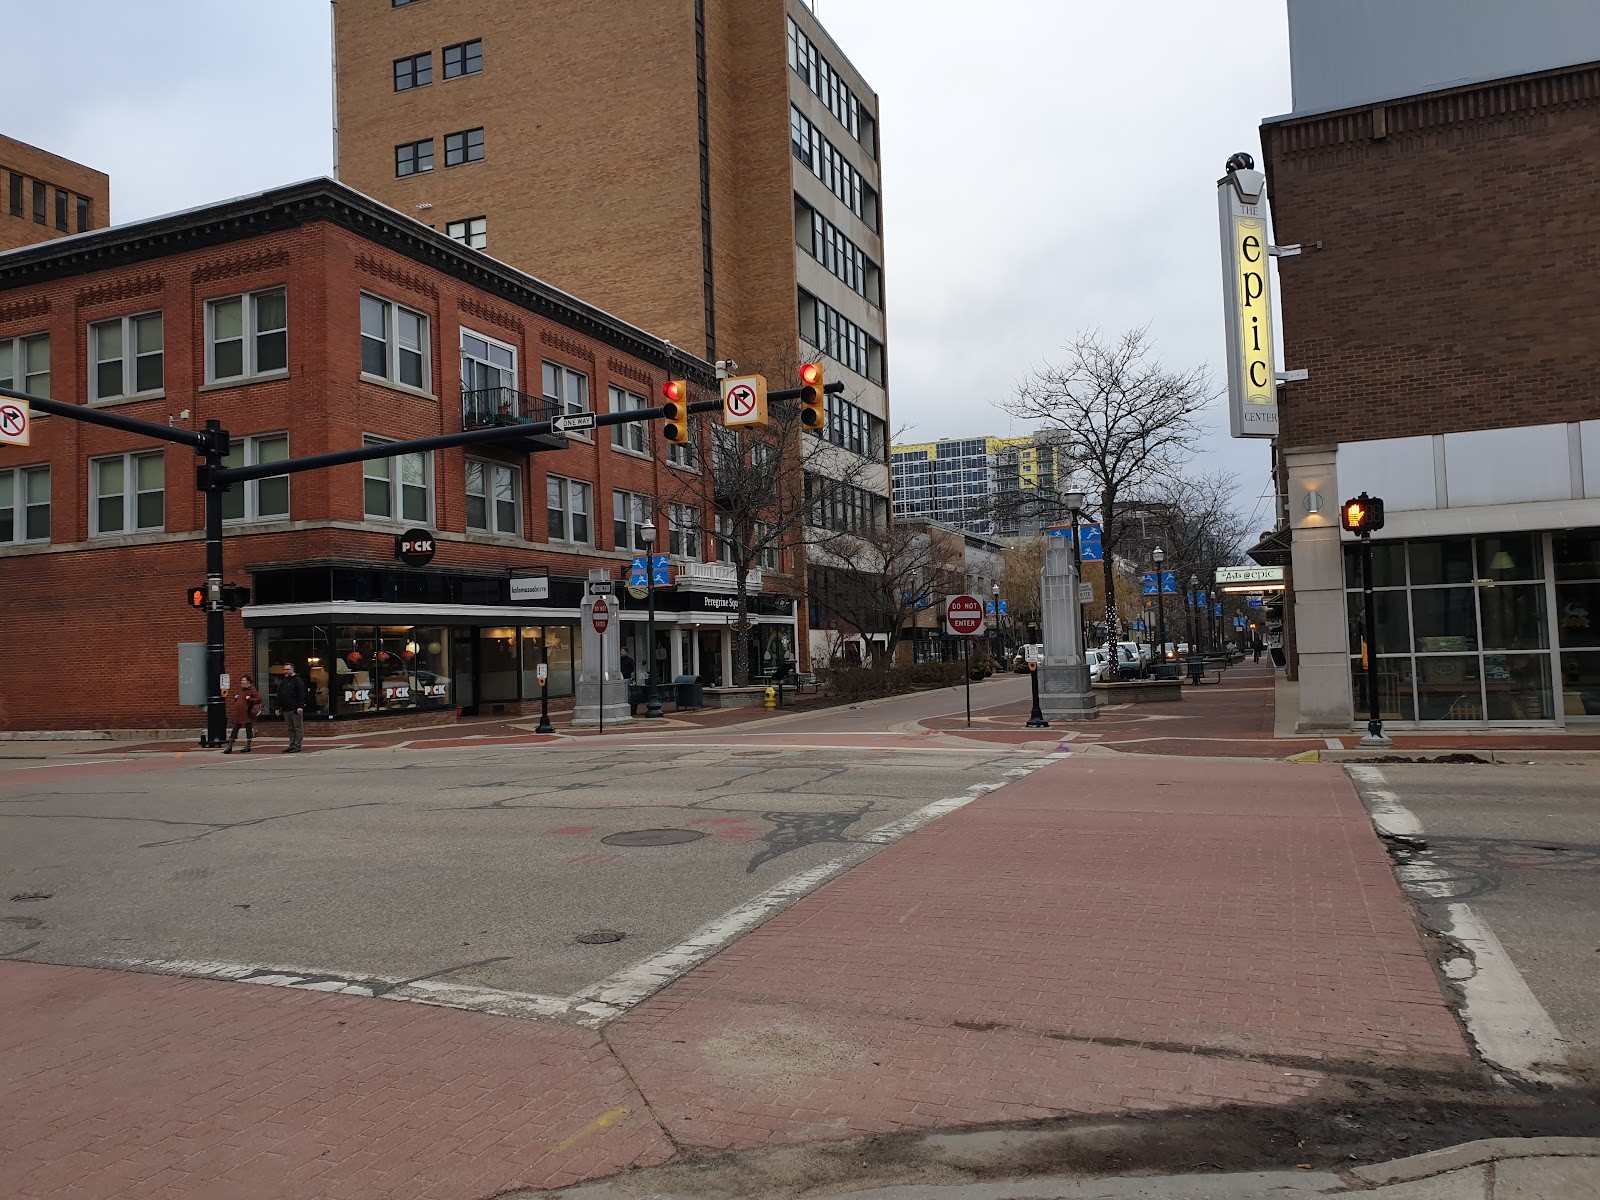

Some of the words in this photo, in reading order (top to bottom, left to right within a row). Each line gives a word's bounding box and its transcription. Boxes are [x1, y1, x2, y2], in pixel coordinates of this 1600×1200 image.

[1240, 204, 1258, 216] THE
[1242, 234, 1267, 388] epic
[1244, 411, 1277, 423] CENTER
[1226, 571, 1242, 581] Arts
[602, 584, 610, 592] WAY
[704, 597, 728, 609] Peregrine
[952, 602, 961, 610] DO
[964, 602, 977, 610] NOT
[954, 619, 976, 627] ENTER
